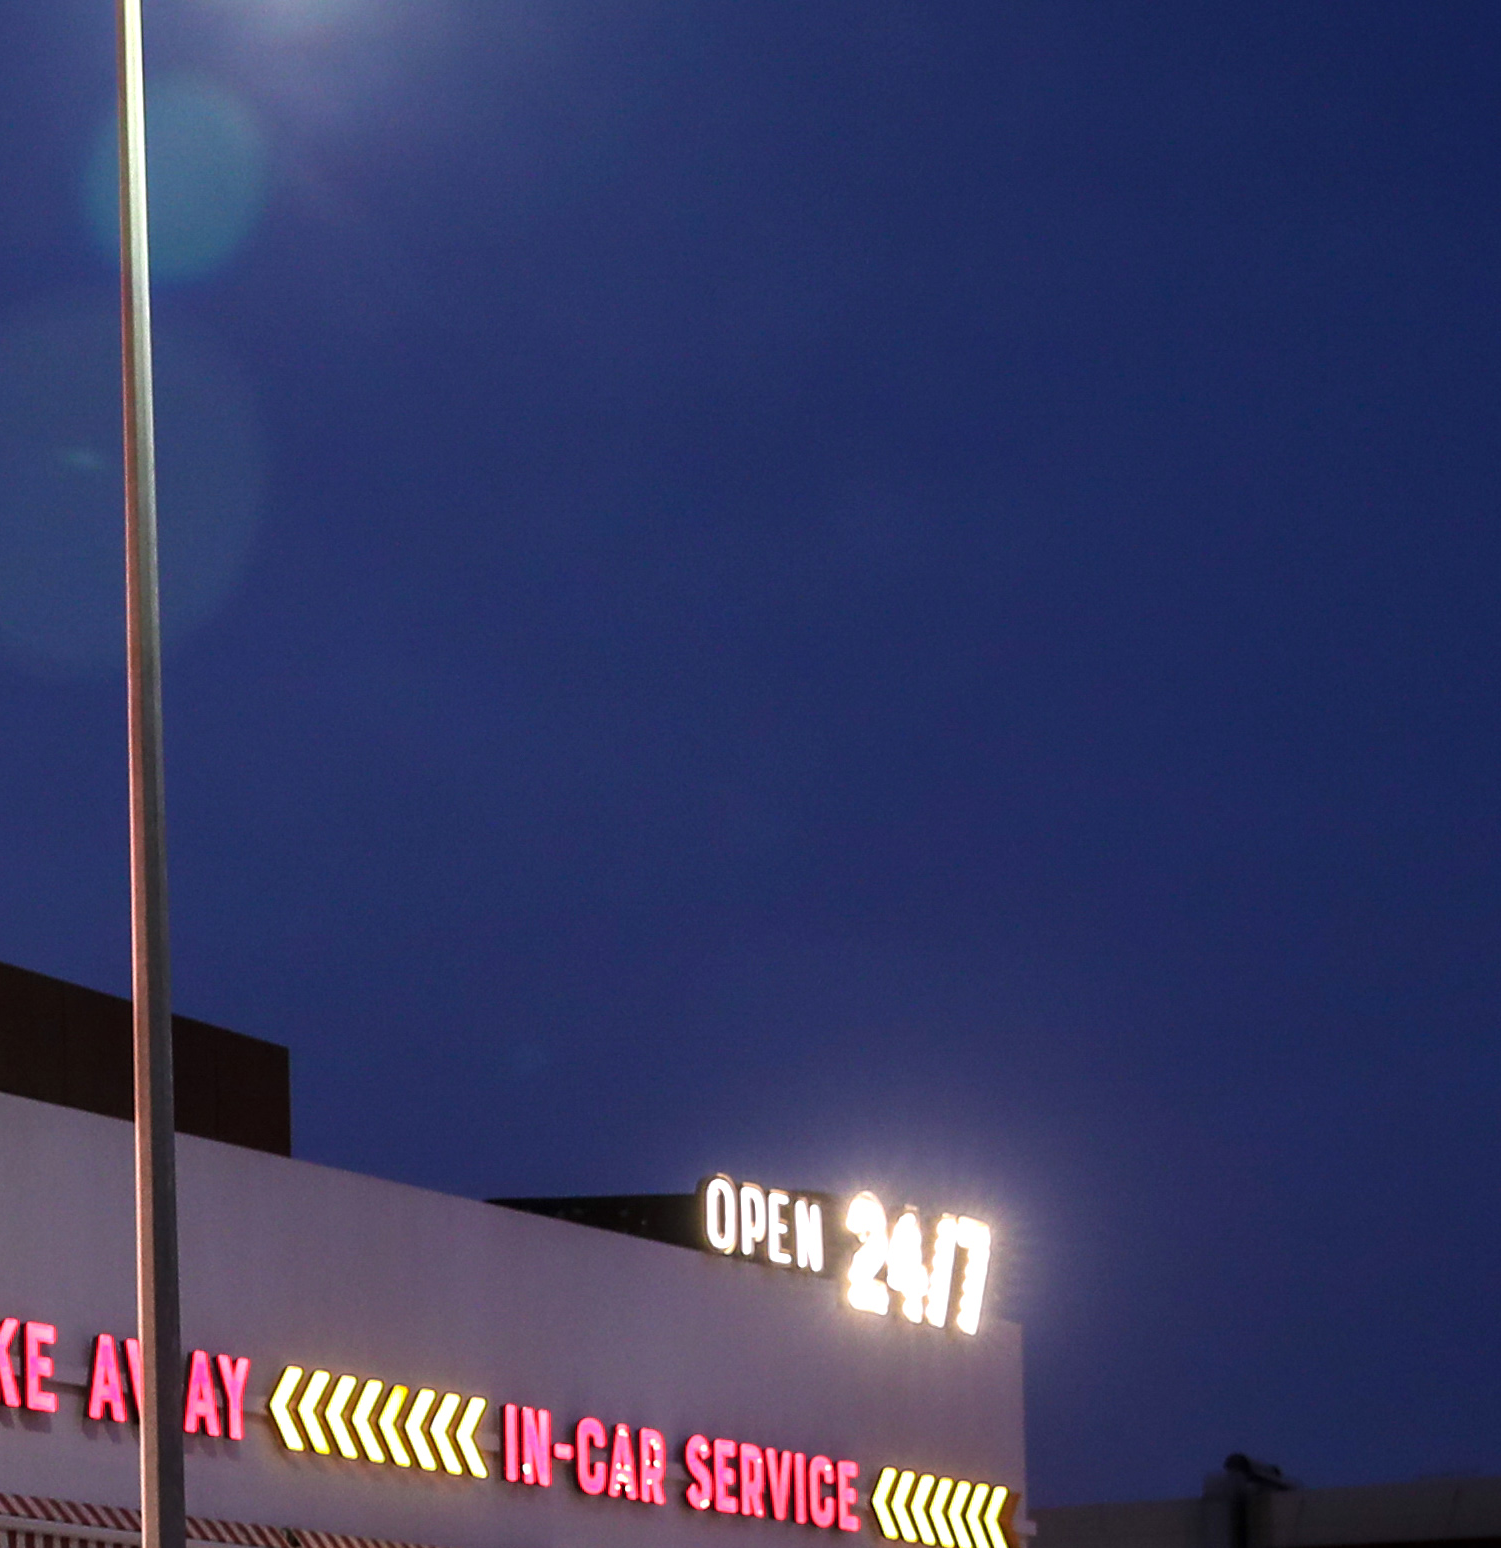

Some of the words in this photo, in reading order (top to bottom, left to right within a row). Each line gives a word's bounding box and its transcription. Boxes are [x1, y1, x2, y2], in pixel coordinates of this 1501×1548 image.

[702, 1172, 823, 1273] OPEN
[844, 1190, 992, 1336] 24/7
[502, 1402, 667, 1506] IN-CAR
[684, 1433, 862, 1533] SERVICE
